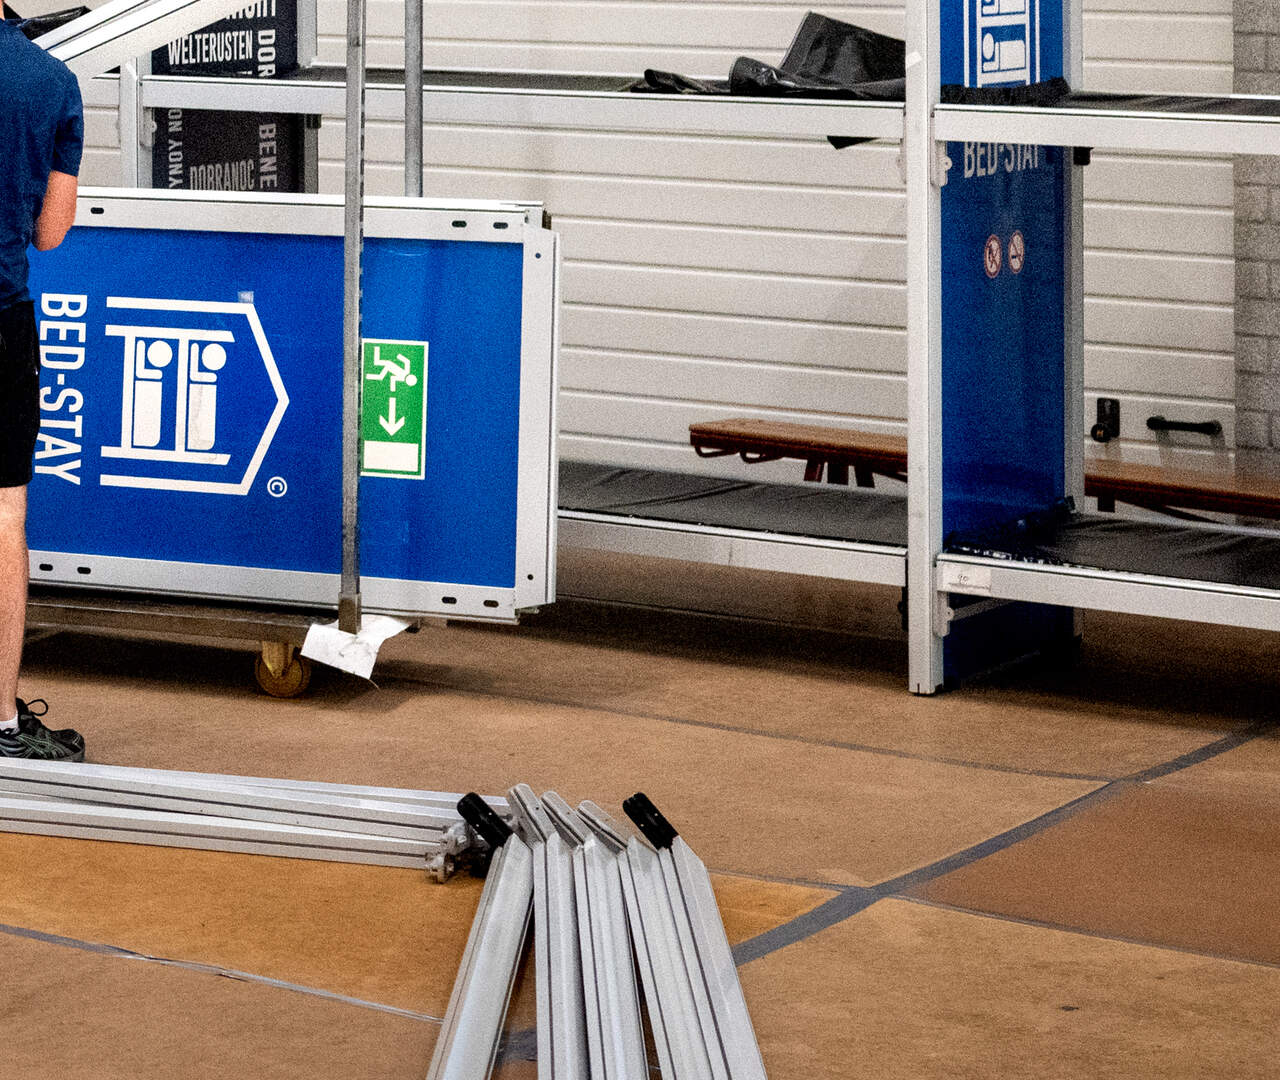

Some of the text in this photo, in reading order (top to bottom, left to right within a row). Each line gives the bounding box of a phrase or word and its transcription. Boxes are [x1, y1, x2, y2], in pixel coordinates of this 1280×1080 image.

[169, 30, 253, 65] WELTERUSTEN
[257, 29, 277, 189] DOR BENE
[34, 292, 88, 486] BED-STAY
